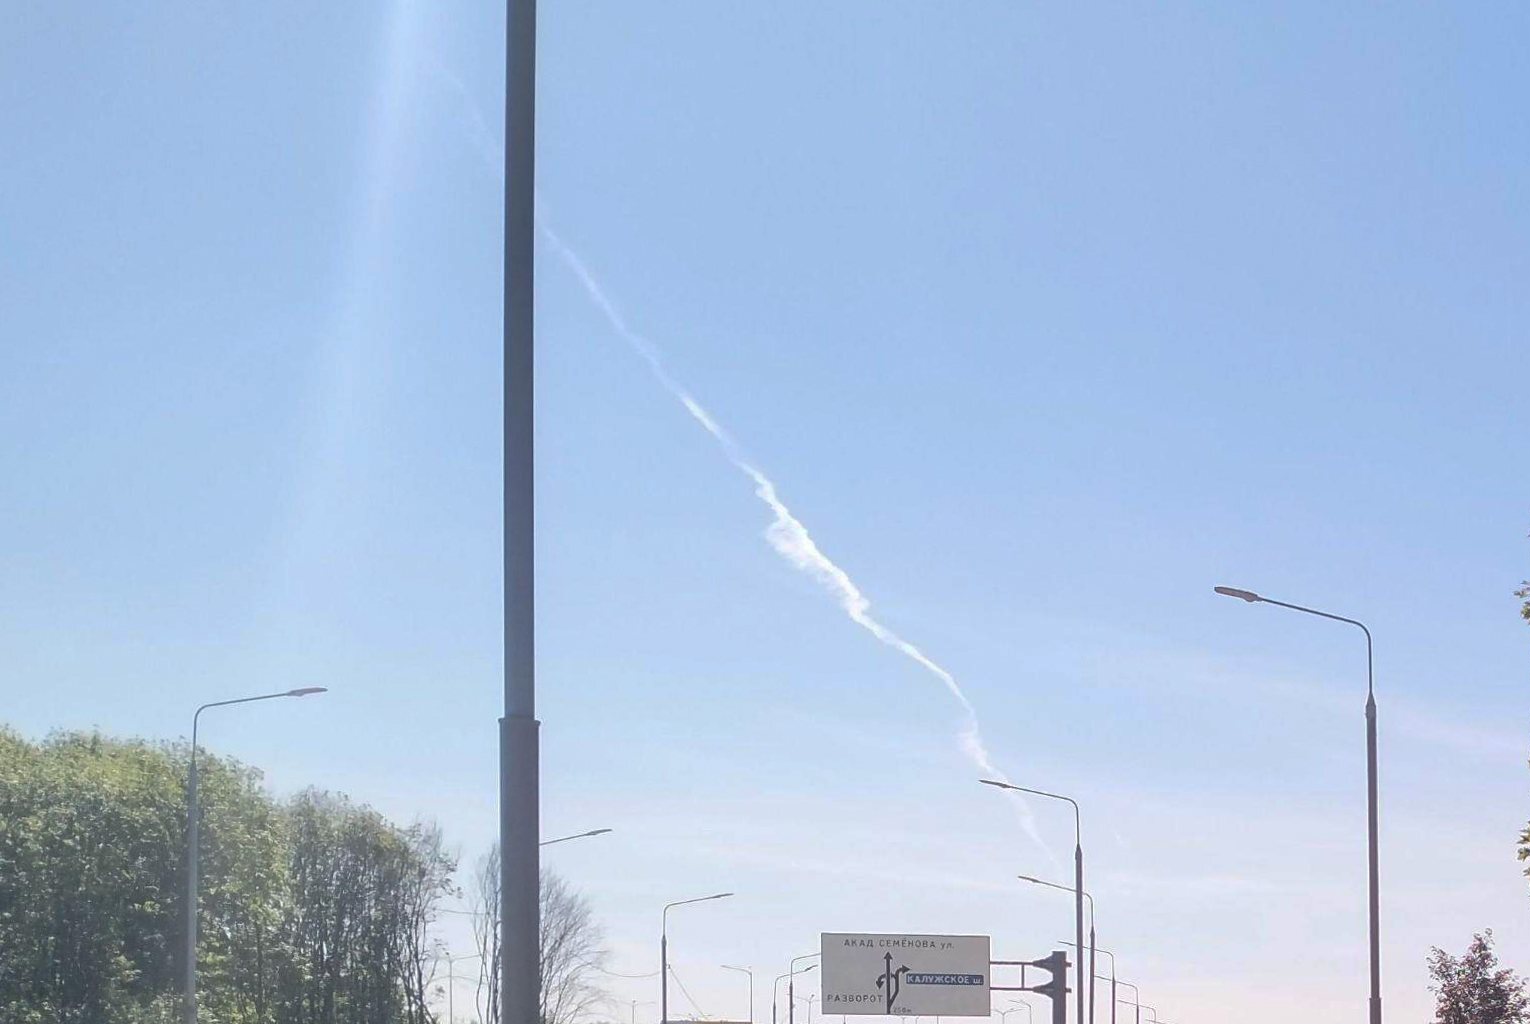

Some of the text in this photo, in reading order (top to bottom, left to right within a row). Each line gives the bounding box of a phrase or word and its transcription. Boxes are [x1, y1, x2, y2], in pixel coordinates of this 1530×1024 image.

[844, 939, 874, 948] АКАД
[879, 937, 936, 949] СЕМЁНОВА
[907, 974, 969, 985] КАЛУЖСКОЕ
[827, 994, 883, 1003] РАЗВОРОТ
